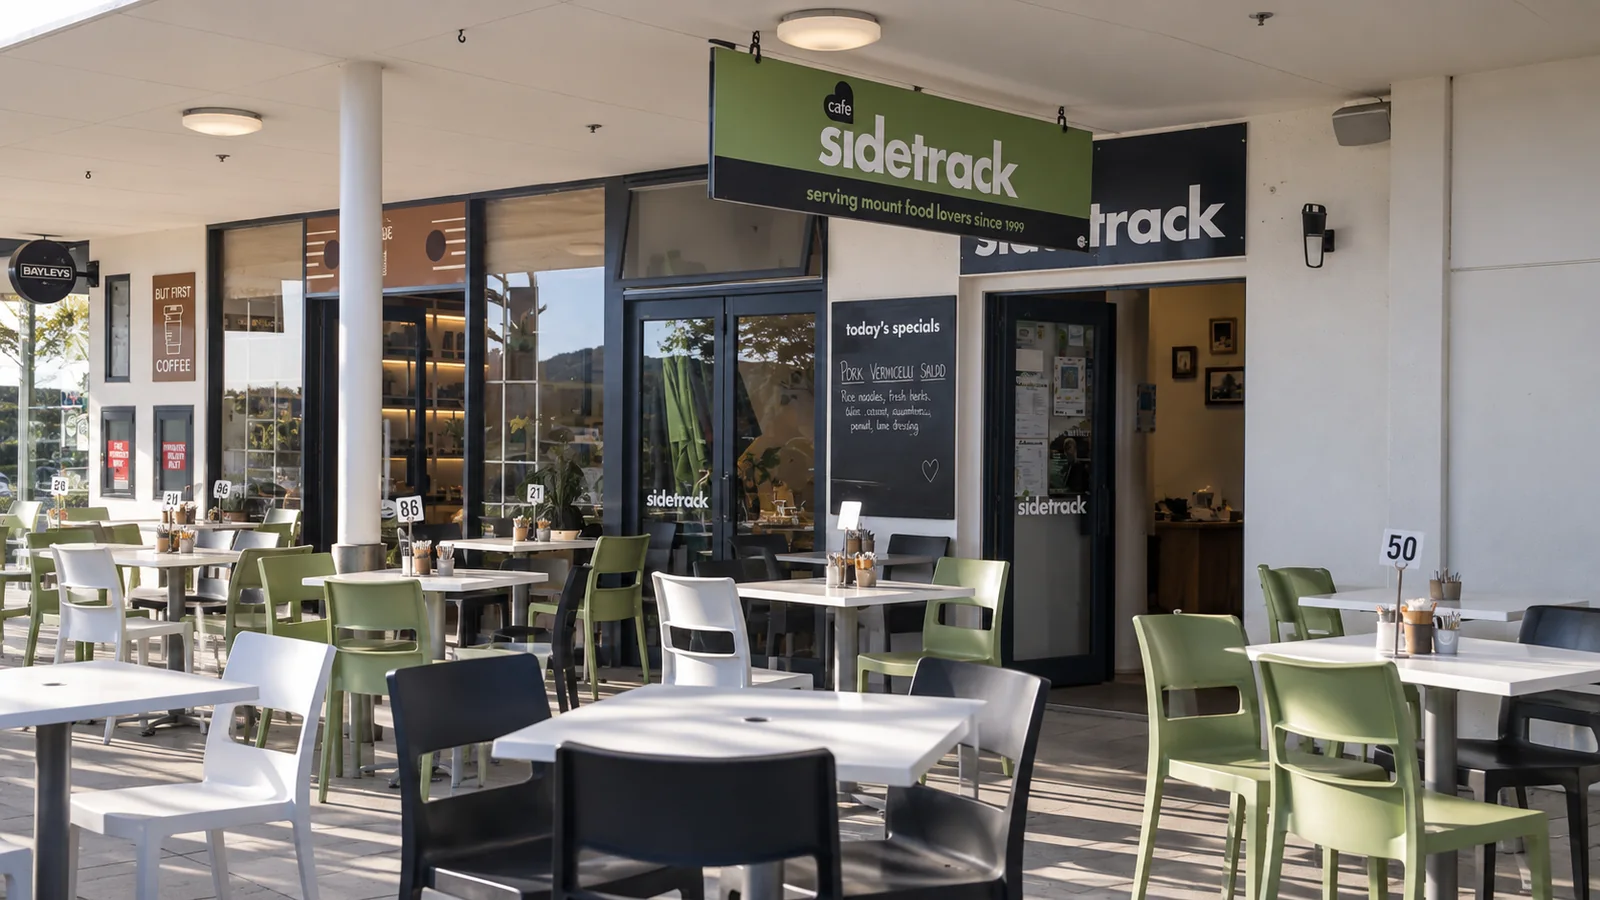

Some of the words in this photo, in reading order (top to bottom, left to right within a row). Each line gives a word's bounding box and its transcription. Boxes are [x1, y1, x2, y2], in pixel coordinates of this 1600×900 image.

[828, 99, 851, 116] cafe
[818, 114, 1018, 198] sidetrack
[806, 188, 857, 211] serving
[861, 197, 902, 214] mount
[905, 199, 934, 219] food
[936, 203, 971, 225] lovers
[974, 212, 1002, 230] since
[1005, 219, 1025, 233] 1999
[155, 288, 170, 300] BUT
[171, 286, 191, 299] FIRST
[846, 320, 890, 339] today's
[892, 317, 940, 338] specials
[156, 359, 191, 373] COFFEE
[529, 487, 540, 500] 21
[646, 488, 710, 509] sidetrack
[400, 499, 419, 518] 86
[1017, 495, 1087, 516] sidetrack
[1387, 534, 1417, 562] 50
